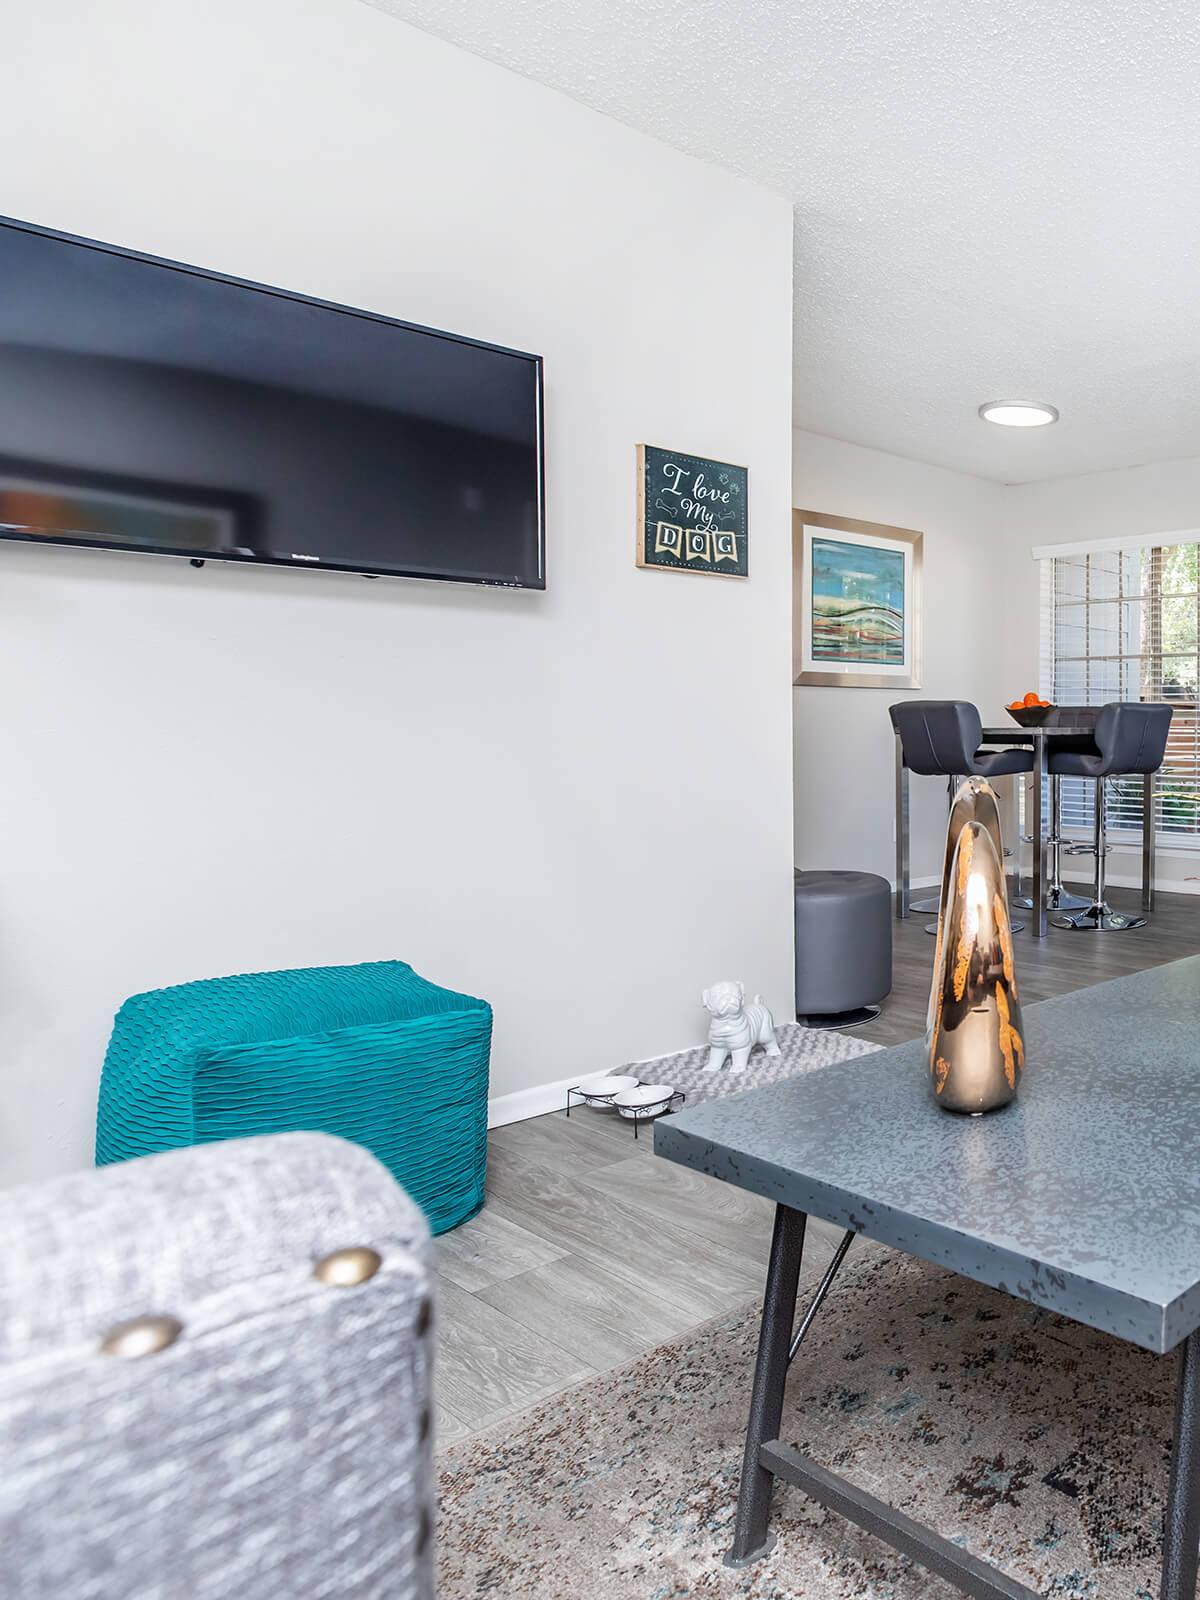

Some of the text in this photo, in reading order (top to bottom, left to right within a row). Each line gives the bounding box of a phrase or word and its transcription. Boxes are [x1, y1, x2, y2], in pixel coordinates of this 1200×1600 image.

[661, 463, 730, 503] I love
[680, 498, 719, 533] My
[661, 527, 731, 552] DOG
